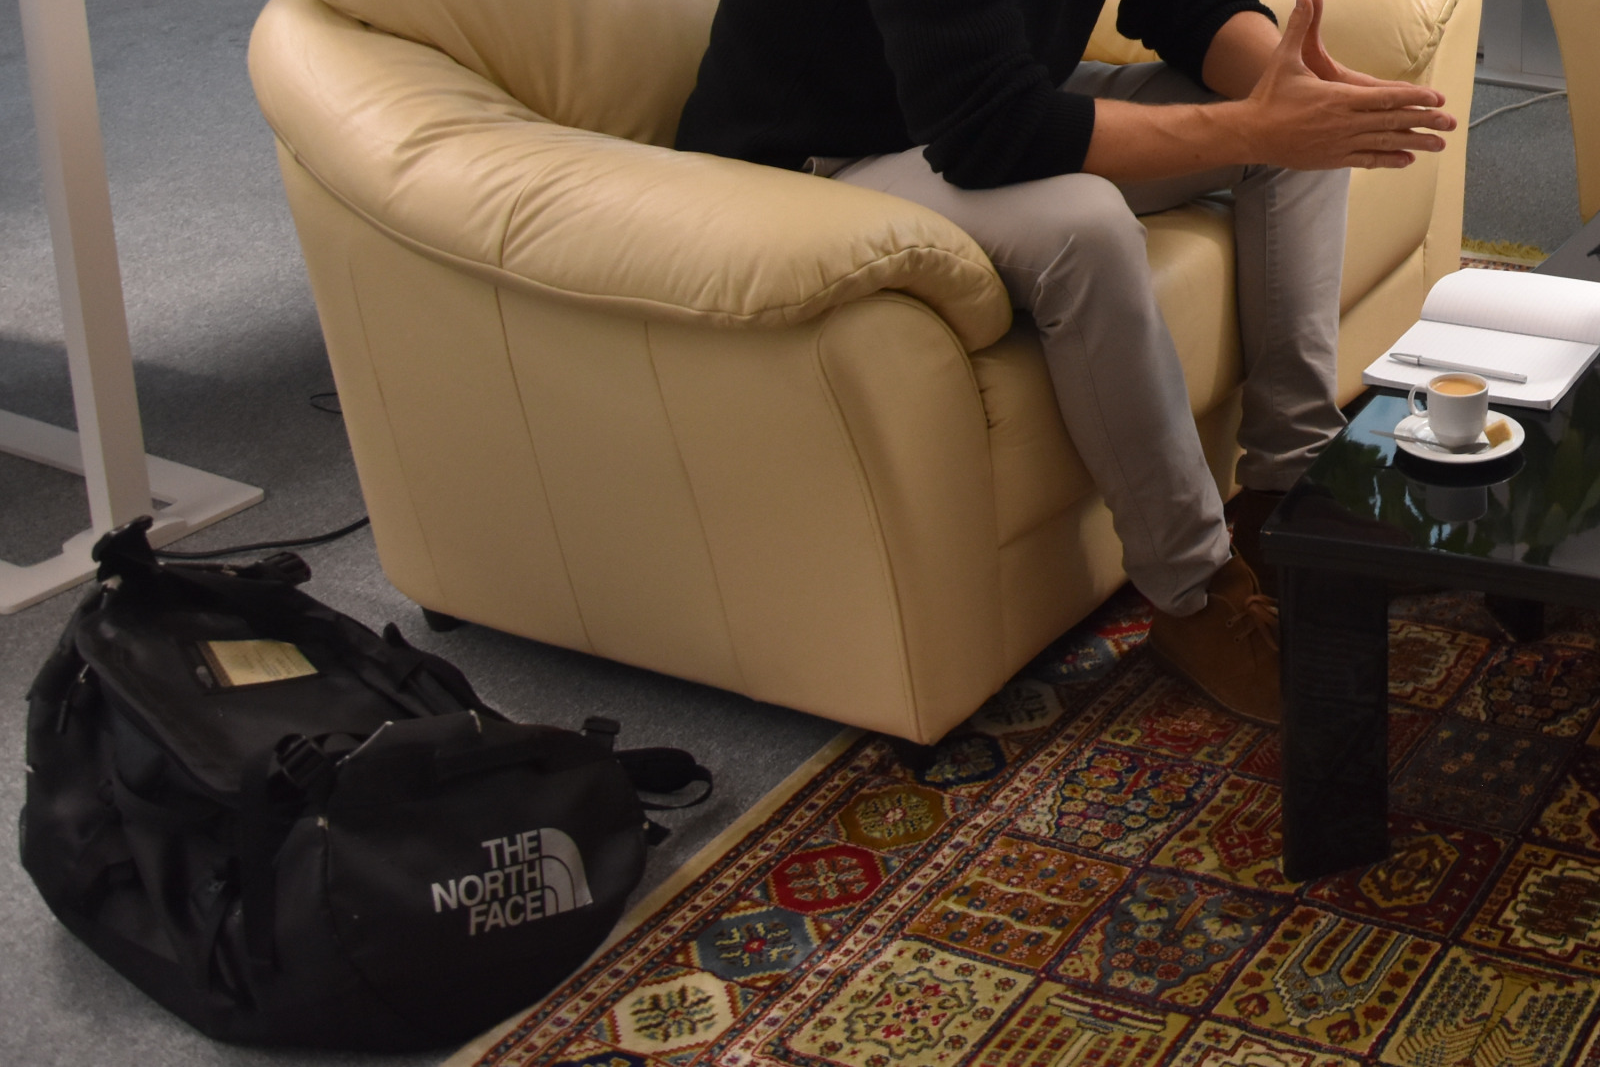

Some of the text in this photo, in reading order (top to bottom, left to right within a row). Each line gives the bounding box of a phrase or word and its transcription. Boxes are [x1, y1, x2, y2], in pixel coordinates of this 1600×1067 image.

[481, 829, 540, 869] THE
[431, 859, 542, 913] NORTH
[470, 890, 544, 936] FACE
